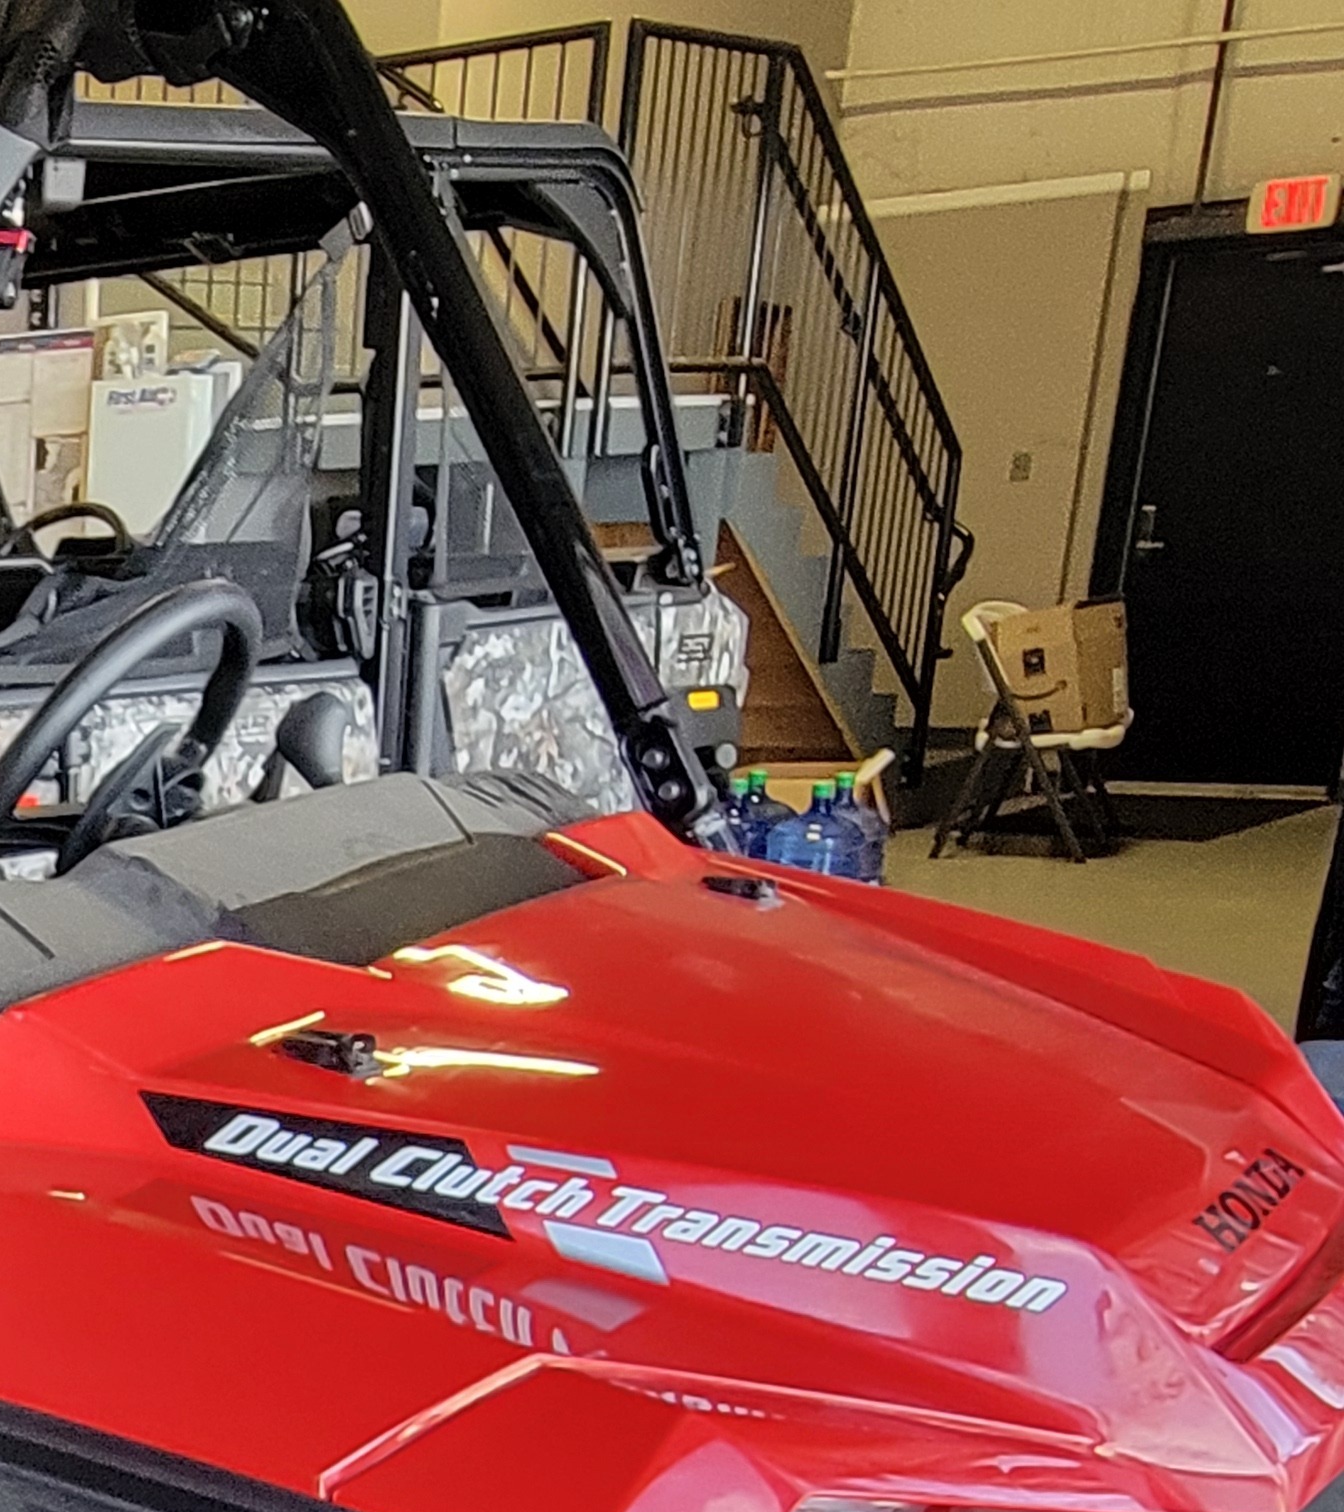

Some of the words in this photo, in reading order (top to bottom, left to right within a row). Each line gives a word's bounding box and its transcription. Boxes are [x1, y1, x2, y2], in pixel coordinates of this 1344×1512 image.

[1262, 179, 1328, 228] EXIT
[204, 1113, 378, 1175] Dual
[370, 1146, 593, 1218] Clutch
[597, 1187, 1068, 1313] Transmission
[1192, 1148, 1305, 1252] HONDA
